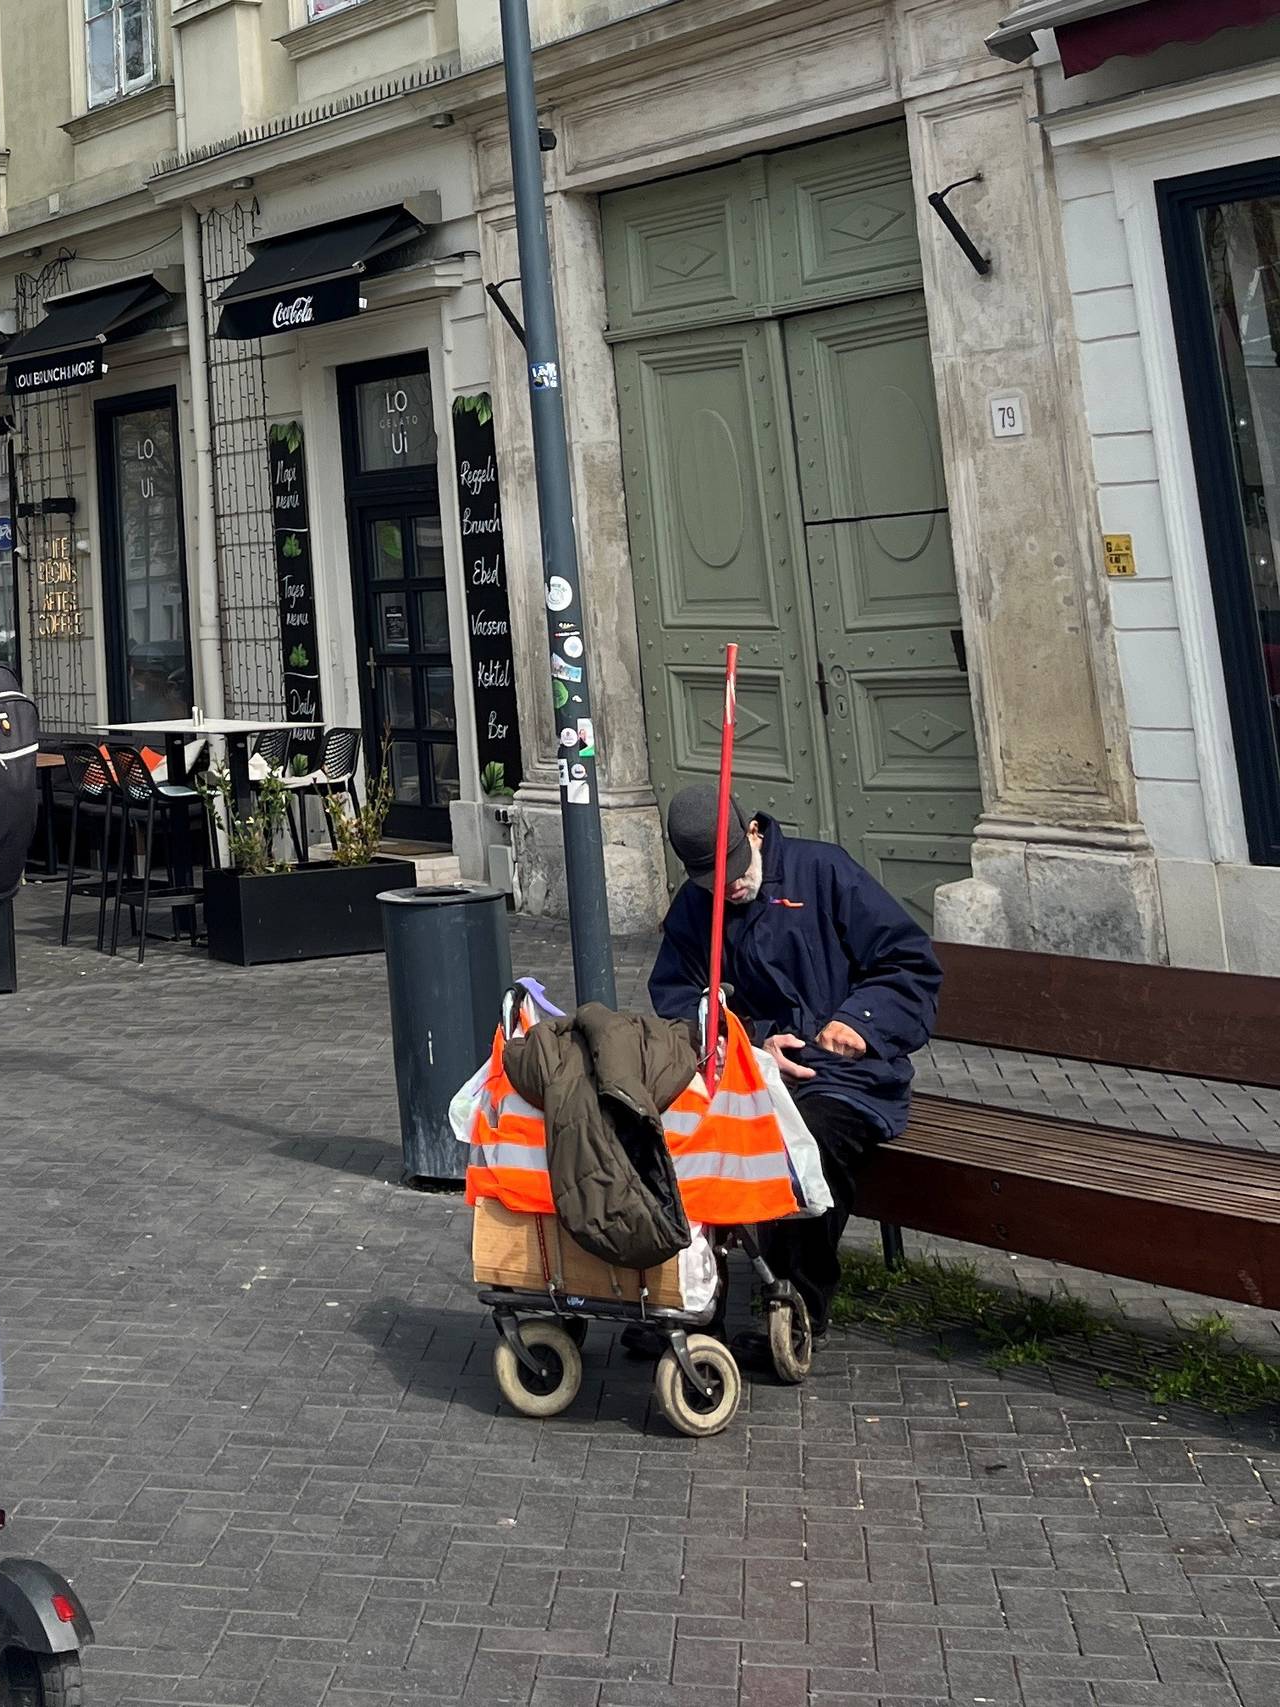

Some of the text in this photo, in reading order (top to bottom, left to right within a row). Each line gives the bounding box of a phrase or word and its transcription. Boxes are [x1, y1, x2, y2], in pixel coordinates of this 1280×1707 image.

[33, 367, 66, 385] BRUNCH
[72, 360, 95, 378] MORE
[385, 389, 407, 413] LO
[998, 406, 1016, 429] 79
[137, 438, 154, 459] LO
[460, 455, 496, 495] Reggeli
[463, 502, 501, 536] Brunch
[281, 574, 305, 608] Tages
[289, 688, 317, 722] Daily
